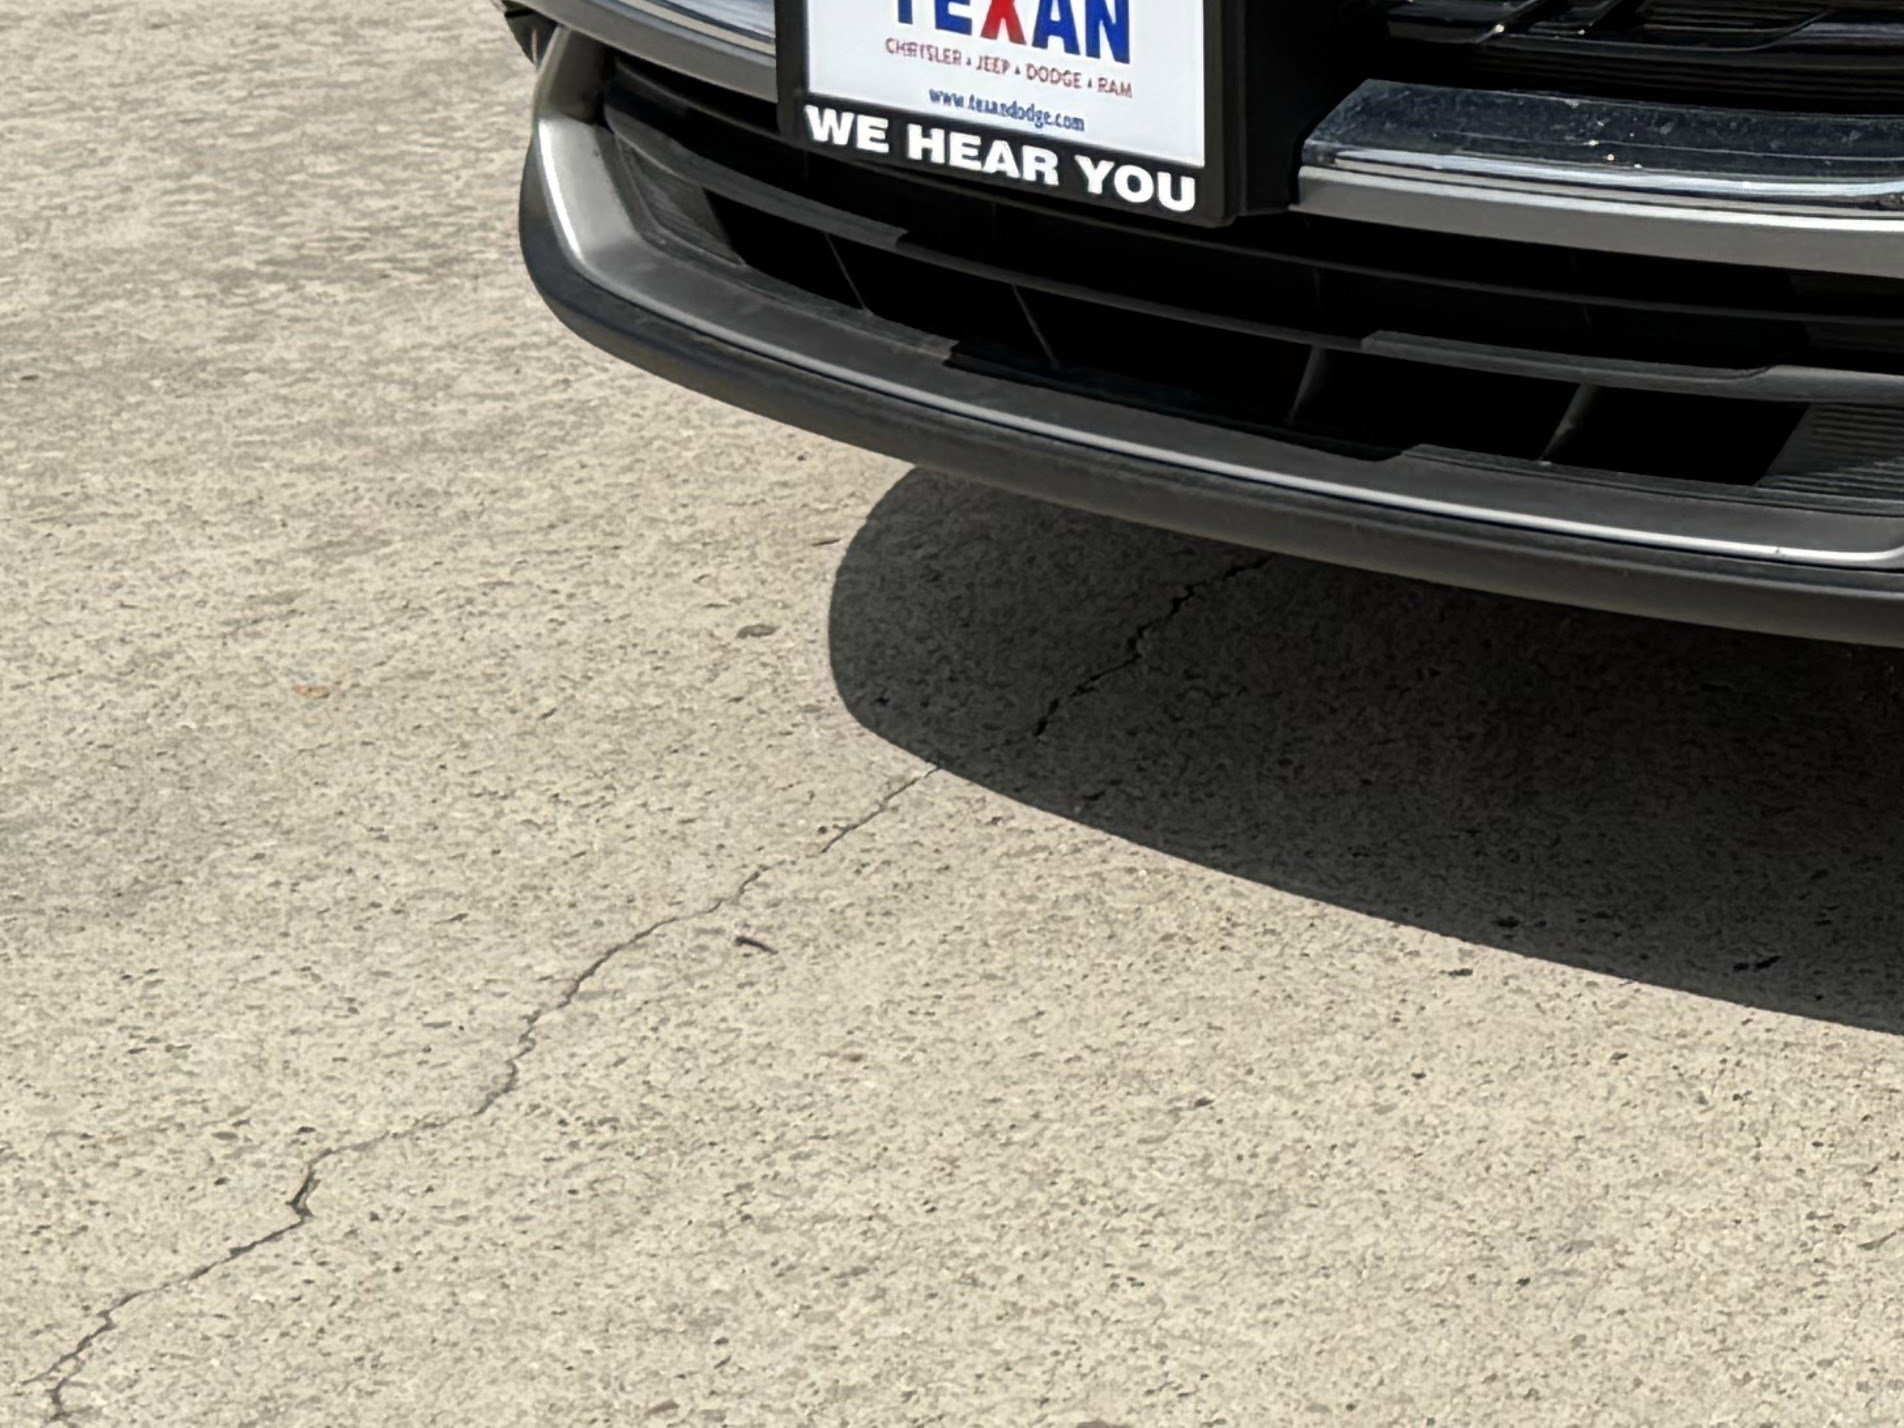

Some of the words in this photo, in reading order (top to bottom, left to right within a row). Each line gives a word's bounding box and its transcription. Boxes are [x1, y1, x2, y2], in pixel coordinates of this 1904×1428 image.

[886, 37, 962, 66] CHRYSLER
[975, 55, 1010, 75] JEEP
[1025, 63, 1082, 89] DODGE
[1097, 77, 1133, 99] RAM
[805, 105, 890, 153] WE
[907, 127, 1060, 186] HEAR
[1075, 154, 1197, 212] YOU
